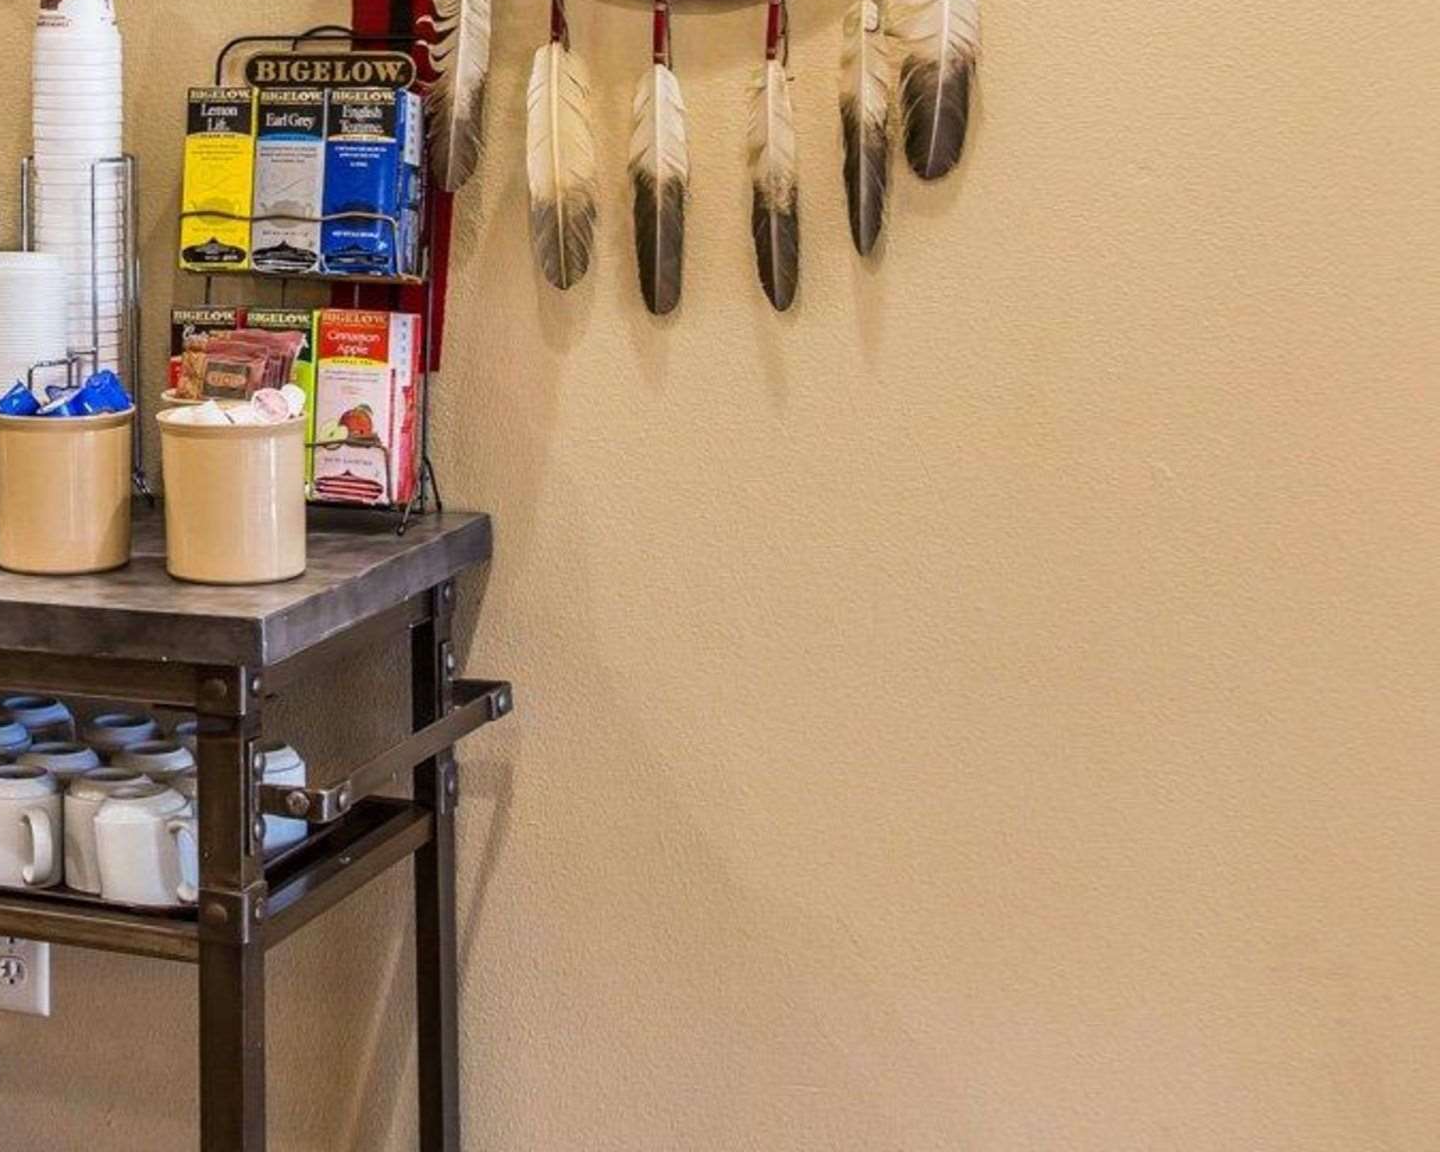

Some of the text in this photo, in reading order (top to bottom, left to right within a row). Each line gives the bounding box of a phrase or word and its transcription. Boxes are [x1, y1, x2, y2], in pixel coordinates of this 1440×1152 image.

[255, 60, 406, 82] BIGELOW
[201, 103, 238, 117] Lemon
[266, 112, 315, 130] Earl Grey
[173, 311, 235, 322] BIGELOW
[248, 313, 309, 323] BIGELOW
